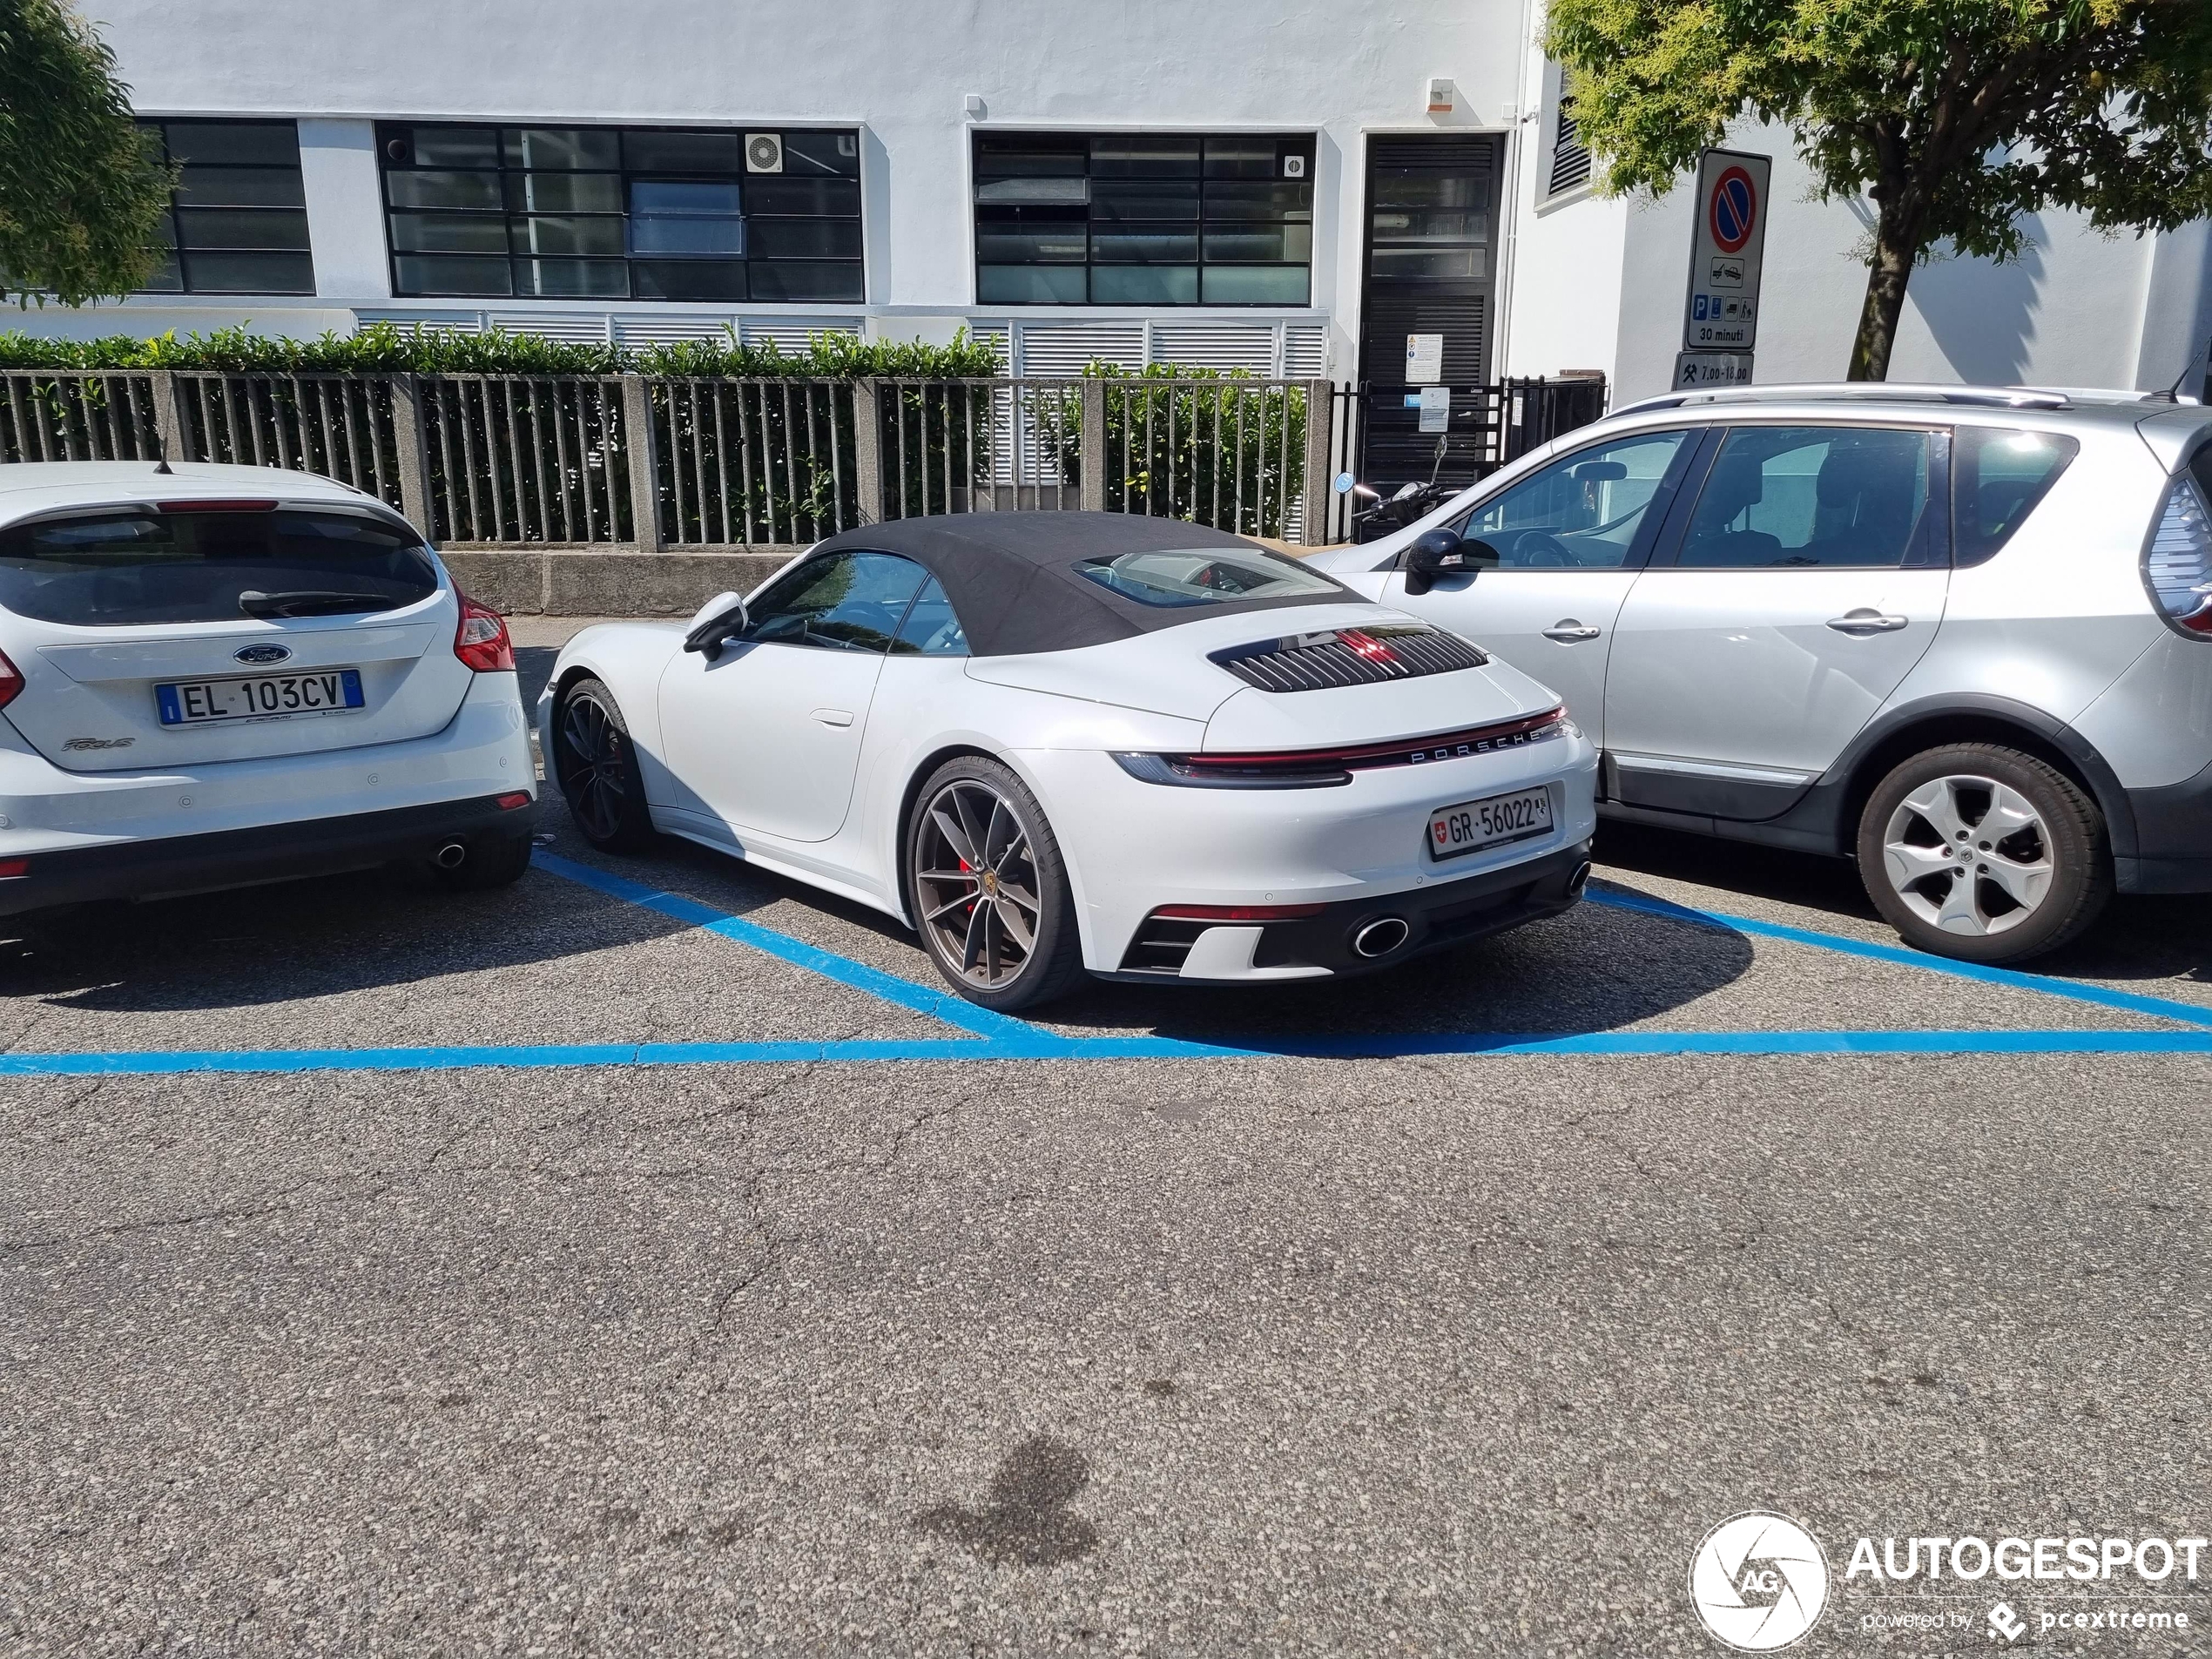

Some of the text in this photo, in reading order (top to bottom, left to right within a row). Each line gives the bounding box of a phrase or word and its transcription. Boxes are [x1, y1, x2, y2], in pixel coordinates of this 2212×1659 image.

[1696, 298, 1705, 317] P
[1700, 327, 1743, 341] 30 minuti
[248, 648, 279, 661] Ford
[183, 675, 337, 718] EL 103CV
[1411, 731, 1541, 764] PORSCHE
